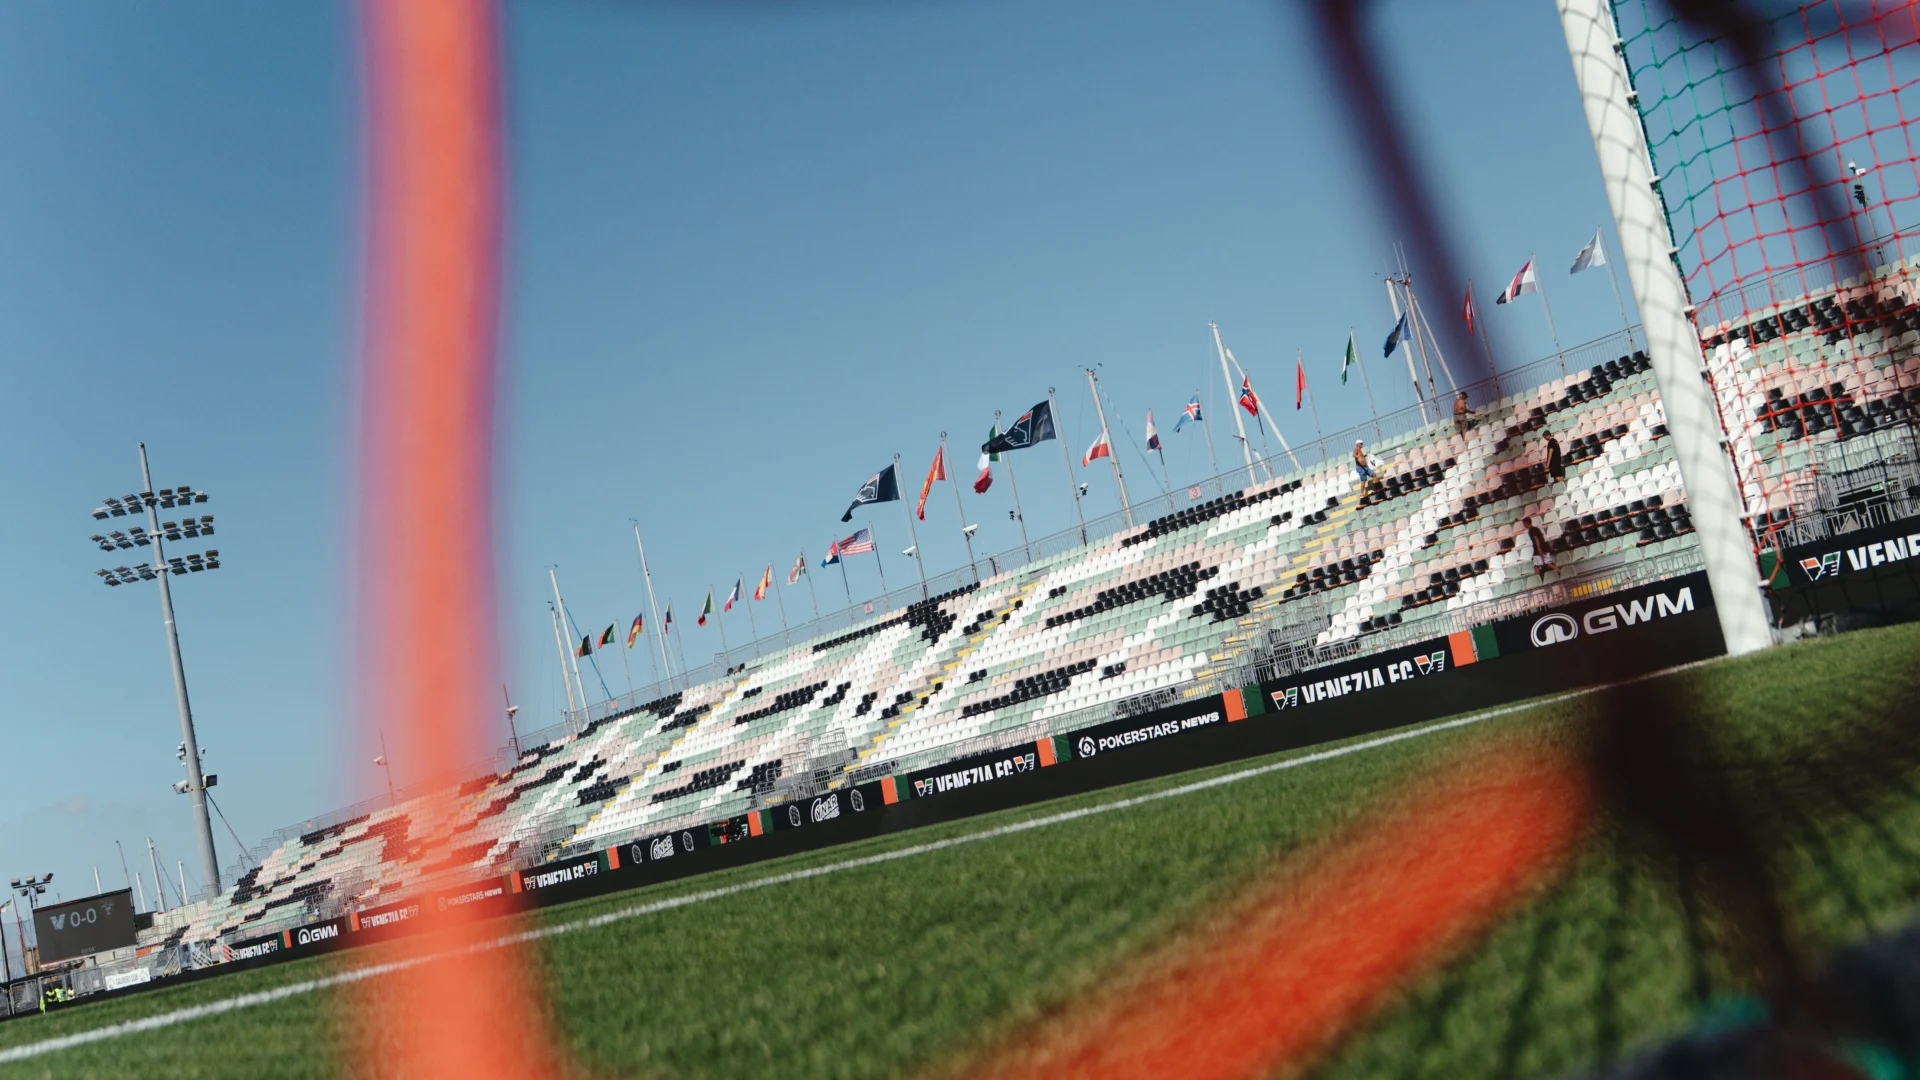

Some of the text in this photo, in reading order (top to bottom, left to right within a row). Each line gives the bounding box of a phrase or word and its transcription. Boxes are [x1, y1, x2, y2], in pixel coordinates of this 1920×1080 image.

[1584, 586, 1695, 635] GWM
[1301, 660, 1414, 704] VENEZIA FC
[1098, 711, 1220, 751] POKERSTARS NEWS
[935, 759, 1014, 793] VENEZIA FC
[536, 864, 585, 888] VENEZIA FC
[70, 907, 97, 927] 0-0
[311, 924, 339, 941] GWM
